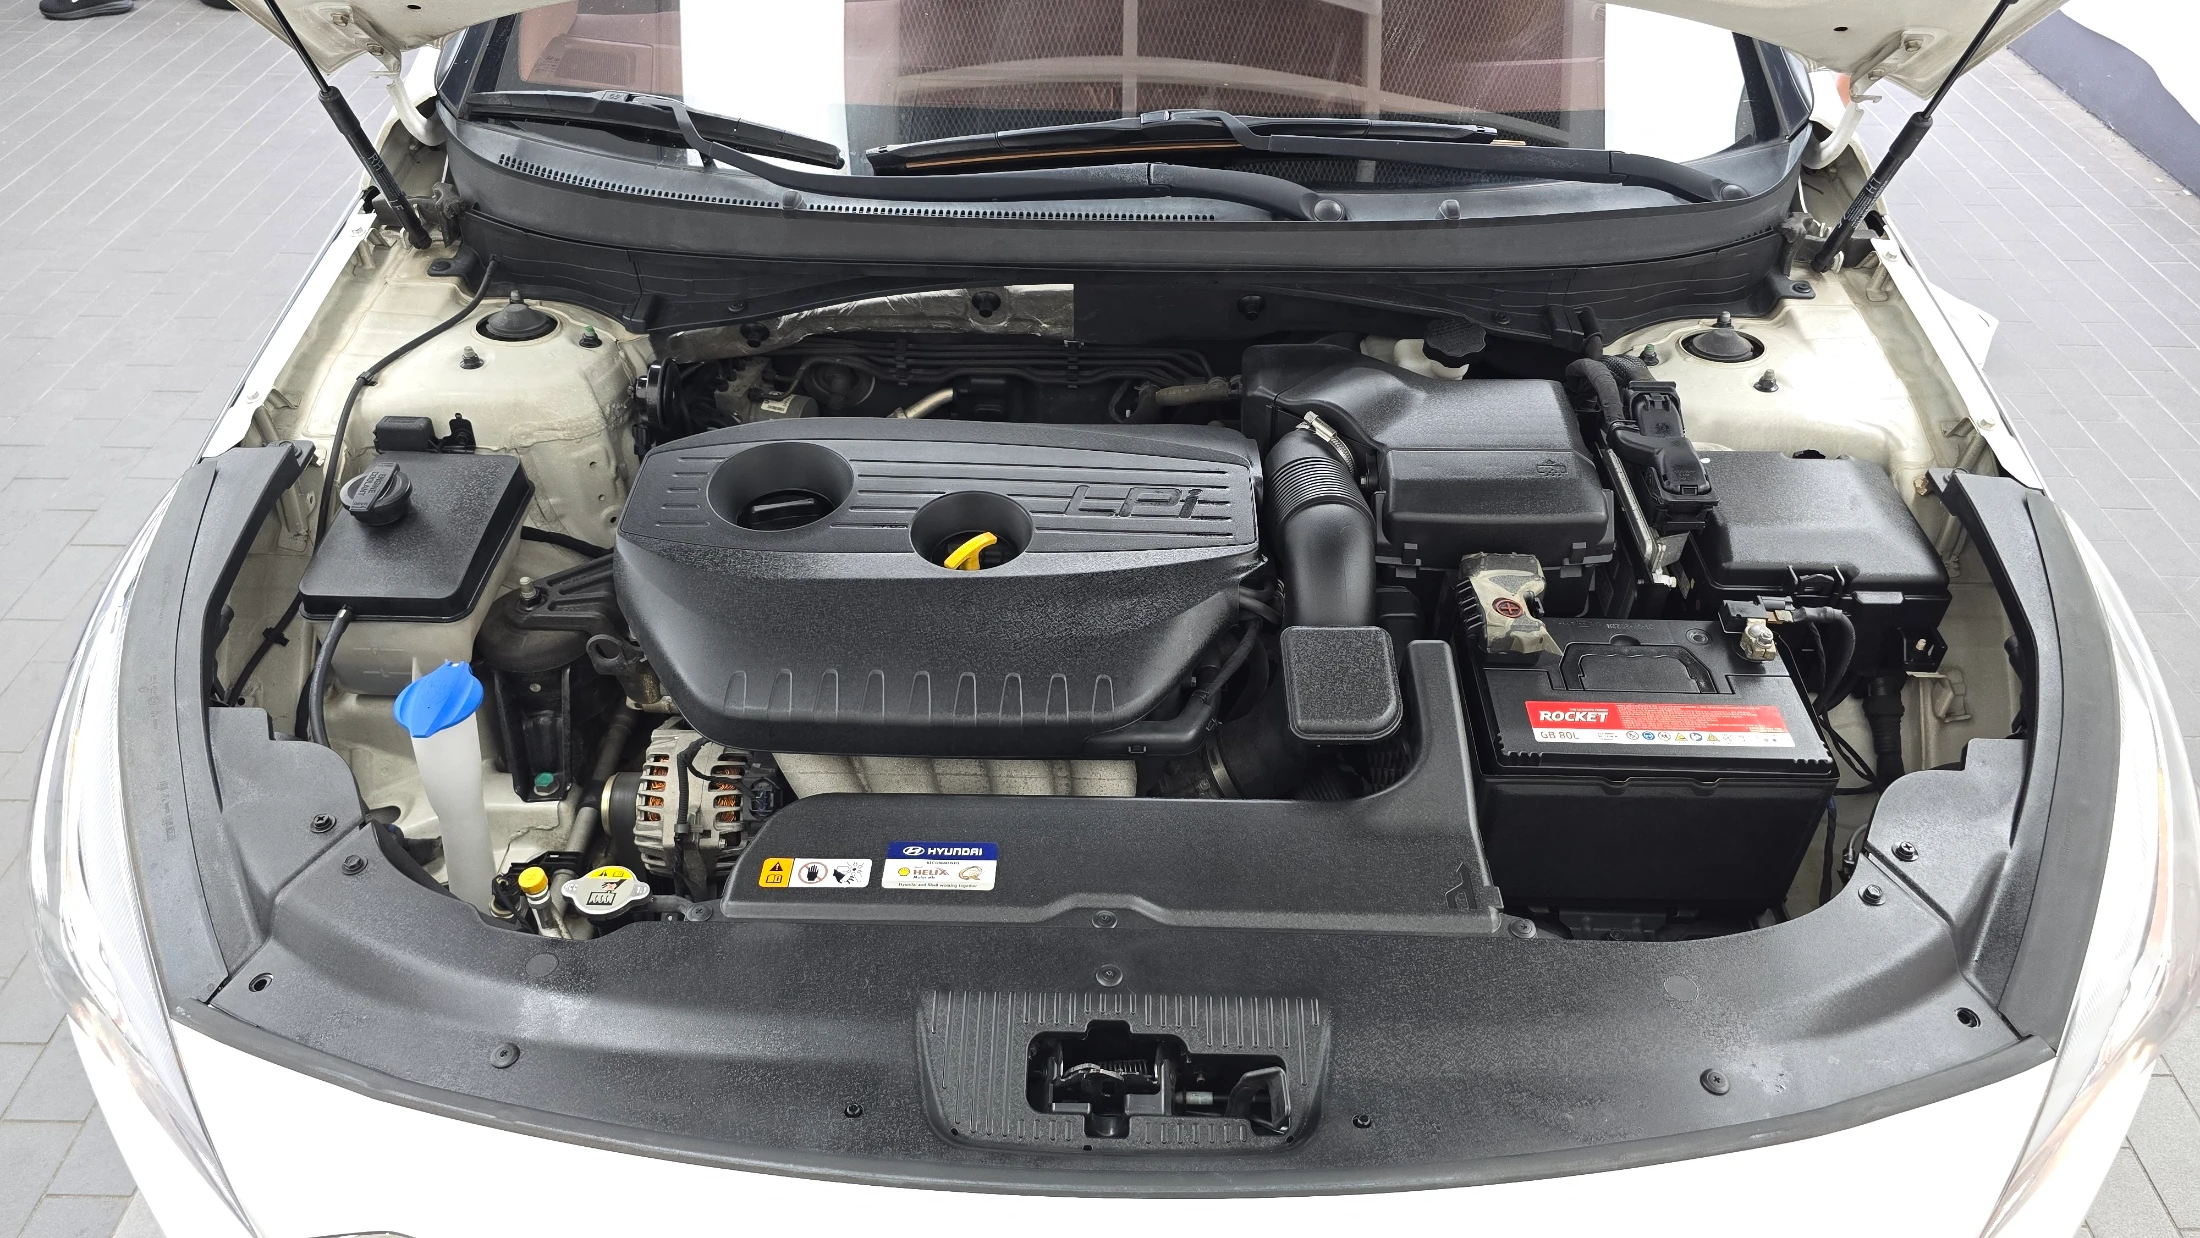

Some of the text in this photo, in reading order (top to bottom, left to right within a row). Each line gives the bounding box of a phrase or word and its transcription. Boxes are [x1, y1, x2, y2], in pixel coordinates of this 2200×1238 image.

[368, 152, 384, 171] RH
[1865, 177, 1881, 194] LH
[358, 471, 380, 496] COOLANT
[368, 473, 387, 494] ENGINE
[1064, 484, 1203, 519] LPi
[1539, 710, 1609, 723] ROCKET
[1540, 731, 1580, 740] GB 80L
[927, 847, 983, 856] HYUNDAI
[913, 868, 949, 876] HELIX
